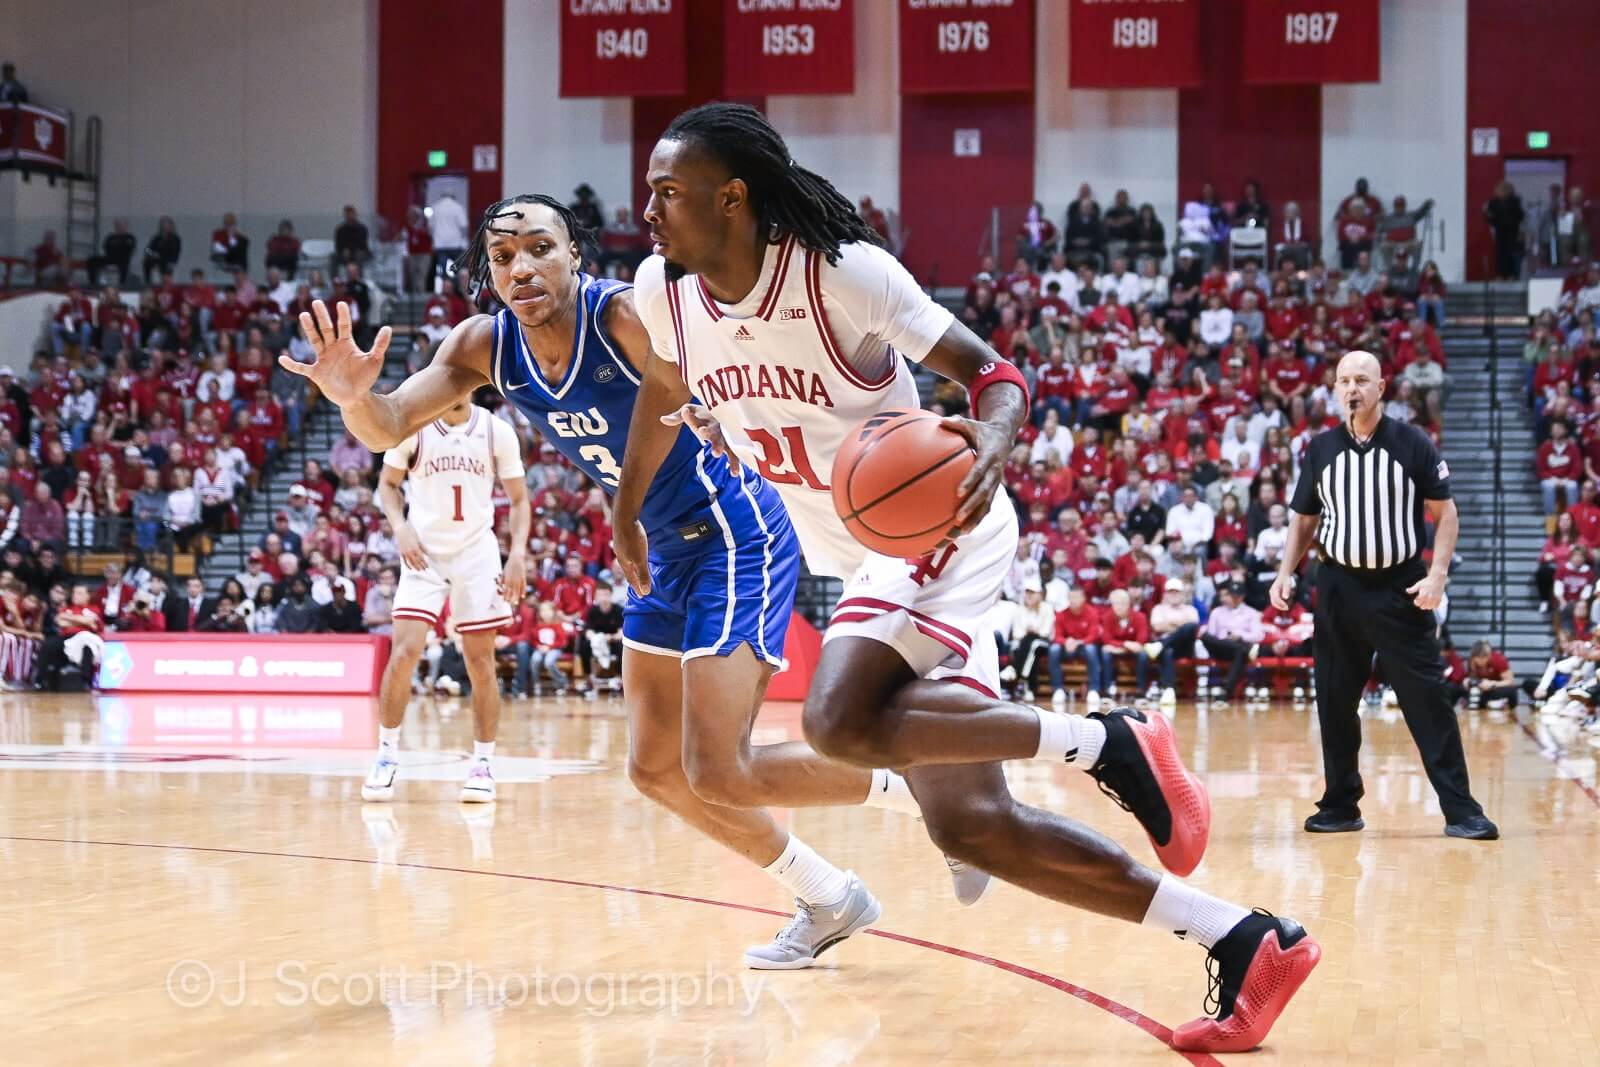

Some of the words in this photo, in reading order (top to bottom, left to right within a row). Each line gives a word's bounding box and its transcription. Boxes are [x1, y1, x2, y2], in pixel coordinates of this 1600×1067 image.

[596, 28, 648, 59] 1940
[763, 24, 815, 55] 1953
[938, 21, 990, 52] 1976
[1113, 17, 1158, 48] 1981
[1285, 12, 1339, 44] 1987
[697, 364, 835, 411] INDIANA
[547, 406, 609, 438] EIU
[424, 455, 486, 478] INDIANA
[579, 444, 622, 487] 3
[743, 426, 832, 491] 21
[452, 485, 465, 521] 1
